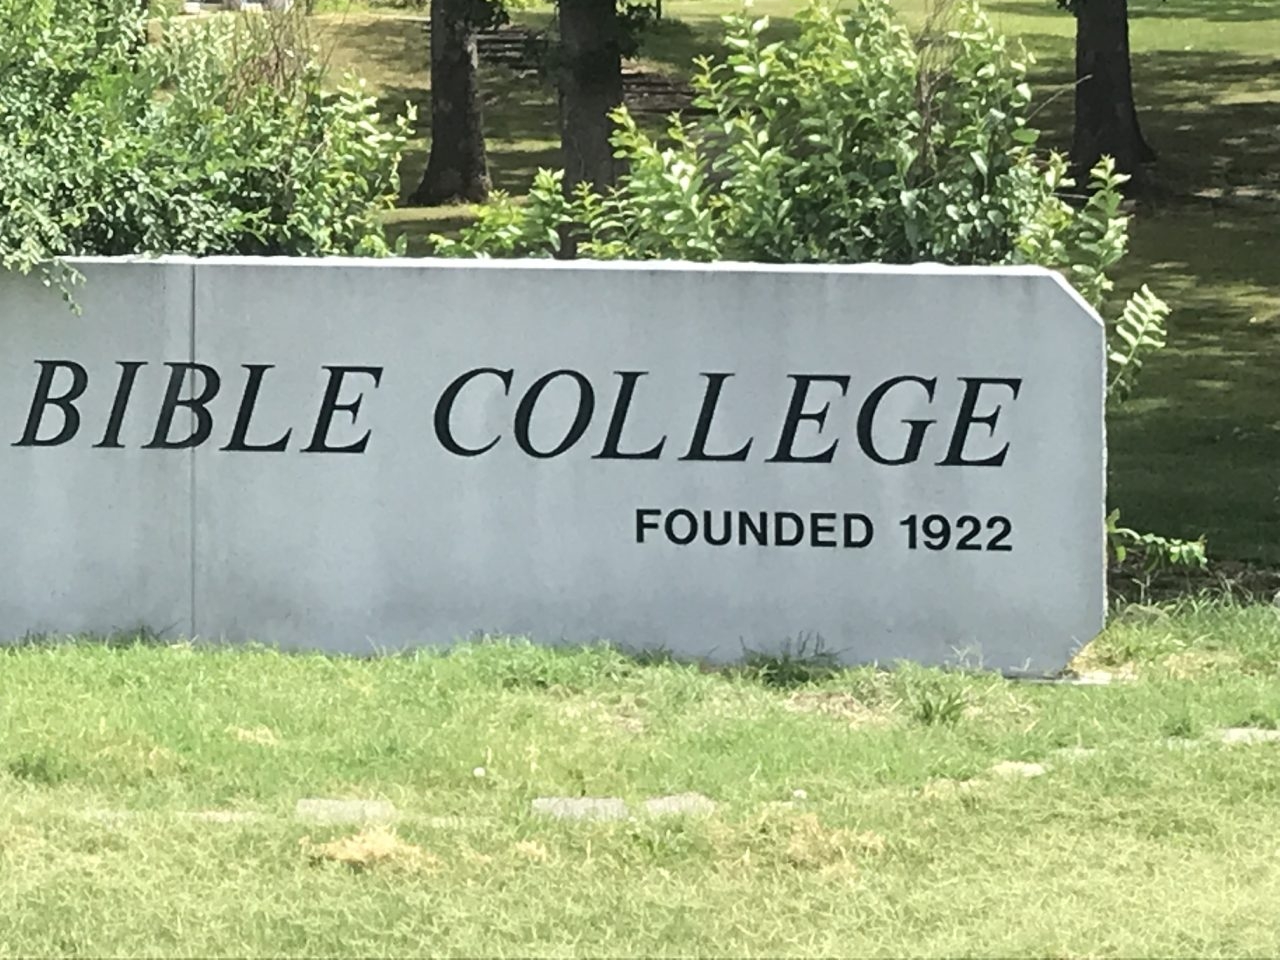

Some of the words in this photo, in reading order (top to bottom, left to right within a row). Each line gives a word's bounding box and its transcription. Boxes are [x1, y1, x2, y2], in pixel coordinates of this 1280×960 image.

[10, 359, 384, 454] BIBLE
[433, 367, 1023, 467] COLLEGE
[636, 508, 874, 549] FOUNDED
[899, 514, 1013, 552] 1922
